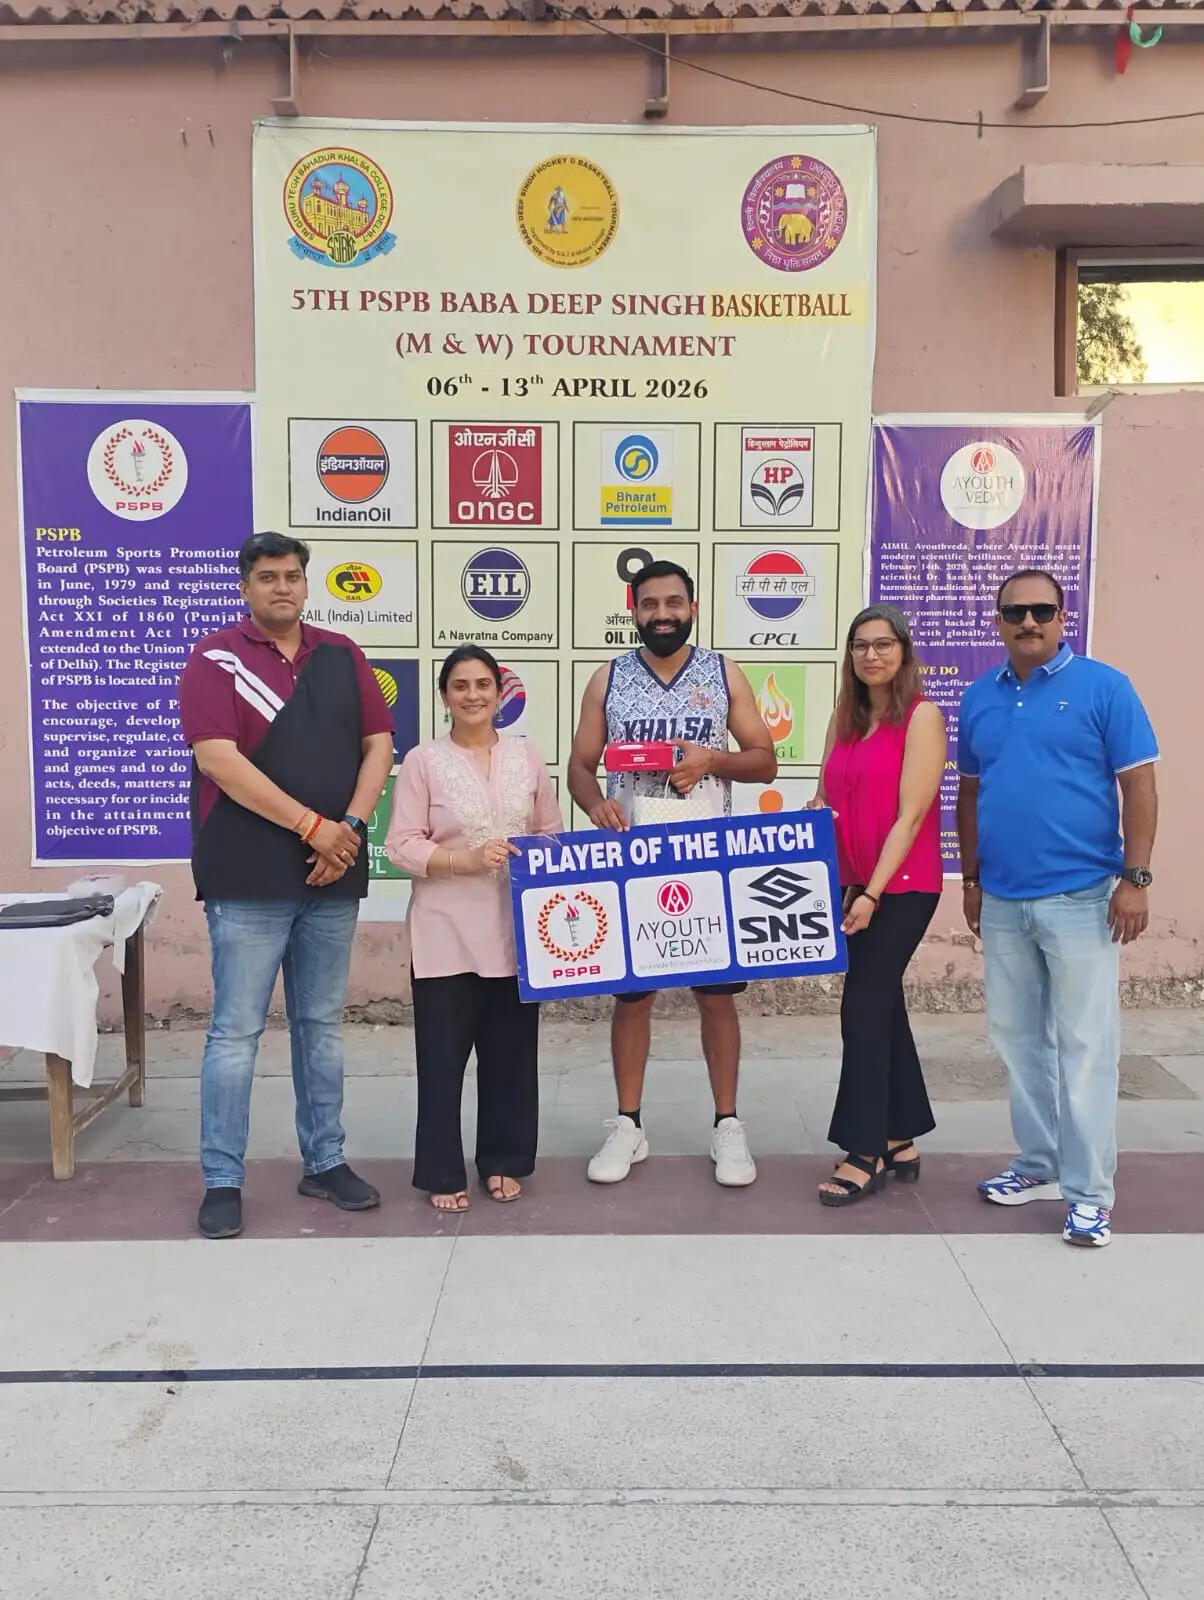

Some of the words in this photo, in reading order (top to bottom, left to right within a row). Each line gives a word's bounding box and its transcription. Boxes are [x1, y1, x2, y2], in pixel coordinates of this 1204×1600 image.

[299, 153, 336, 176] BAHADUR
[338, 154, 370, 173] KHALSA
[288, 175, 301, 199] TEGH
[289, 203, 303, 229] GURU
[302, 230, 315, 241] SRI
[291, 289, 349, 310] 5TH
[359, 290, 430, 312] PSPB
[440, 292, 519, 314] BABA
[527, 292, 602, 315] DEEP
[612, 294, 706, 315] SINGH
[712, 294, 851, 317] BASKETBALL
[396, 333, 432, 359] (M
[442, 333, 467, 354] &
[475, 333, 513, 360] W)
[523, 334, 736, 356] TOURNAMENT
[427, 373, 472, 396] 06th
[501, 374, 543, 397] 13th
[552, 377, 637, 398] APRIL
[645, 379, 708, 398] 2026
[320, 456, 384, 472] इंडियनऑयल
[764, 467, 793, 484] HP
[953, 476, 1013, 489] AYOUTH
[617, 492, 656, 502] Bharat
[116, 502, 163, 510] PSPB
[458, 501, 534, 521] ONGC
[606, 502, 666, 513] Petroleum
[316, 507, 391, 522] IndianOil
[36, 528, 81, 541] PSPB
[36, 547, 107, 557] Petroleum
[116, 547, 161, 561] Sports
[1008, 543, 1049, 552] Ayurveda
[37, 563, 77, 573] Board
[84, 563, 129, 576] (PSPB)
[136, 566, 162, 574] was
[881, 563, 916, 571] February
[972, 563, 998, 571] under
[38, 579, 51, 590] in
[60, 580, 94, 591] June,
[105, 580, 136, 590] 1979
[144, 580, 169, 590] and
[470, 574, 521, 596] EIL
[742, 580, 754, 592] सी
[774, 580, 787, 593] सी
[39, 596, 92, 609] through
[99, 596, 156, 606] Societies
[163, 596, 245, 609] Registration
[926, 594, 957, 603] pharma
[39, 612, 64, 622] Act
[74, 612, 102, 621] XXI
[113, 612, 128, 622] of
[139, 612, 174, 622] 1860
[328, 610, 364, 624] (India)
[368, 612, 412, 623] Limited
[945, 619, 975, 627] backed
[980, 620, 991, 628] by
[39, 628, 136, 638] Amendment
[145, 628, 172, 638] Act
[438, 630, 447, 640] A
[450, 631, 497, 640] Navratna
[502, 631, 553, 643] Company
[605, 632, 624, 644] OIL
[750, 632, 799, 646] CPCL
[946, 630, 986, 638] globally
[40, 643, 100, 653] extended
[104, 644, 117, 653] to
[120, 643, 140, 653] the
[144, 644, 185, 654] Union
[41, 659, 57, 669] of
[58, 659, 101, 672] Delhi).
[106, 659, 132, 669] The
[940, 666, 958, 675] DO
[41, 675, 58, 685] of
[58, 675, 92, 685] PSPB
[95, 675, 105, 685] is
[109, 675, 156, 685] located
[159, 675, 172, 685] in
[42, 699, 68, 709] The
[76, 700, 138, 713] objective
[147, 699, 162, 709] of
[43, 717, 117, 728] encourage,
[624, 716, 713, 743] KHALSA
[44, 732, 110, 744] supervise,
[113, 731, 170, 744] regulate,
[44, 747, 69, 757] and
[78, 747, 136, 760] organize
[45, 763, 69, 772] and
[74, 763, 115, 776] games
[121, 763, 145, 772] and
[152, 764, 164, 772] to
[170, 763, 186, 772] do
[45, 779, 74, 790] acts,
[79, 779, 120, 790] deeds,
[125, 780, 175, 788] matters
[46, 796, 108, 807] necessary
[112, 794, 132, 804] for
[133, 796, 149, 804] or
[46, 810, 60, 820] in
[71, 810, 94, 819] the
[104, 810, 191, 820] attainment
[47, 826, 106, 838] objective
[108, 826, 120, 835] of
[124, 825, 161, 835] PSPB.
[528, 841, 623, 876] PLAYER
[629, 838, 663, 866] OF
[669, 831, 718, 862] THE
[726, 822, 814, 857] MATCH
[636, 915, 721, 942] AYOUTH
[738, 911, 830, 946] SNS
[655, 939, 707, 959] VEDA
[747, 945, 825, 964] HOCKEY
[553, 965, 601, 979] PSPB
